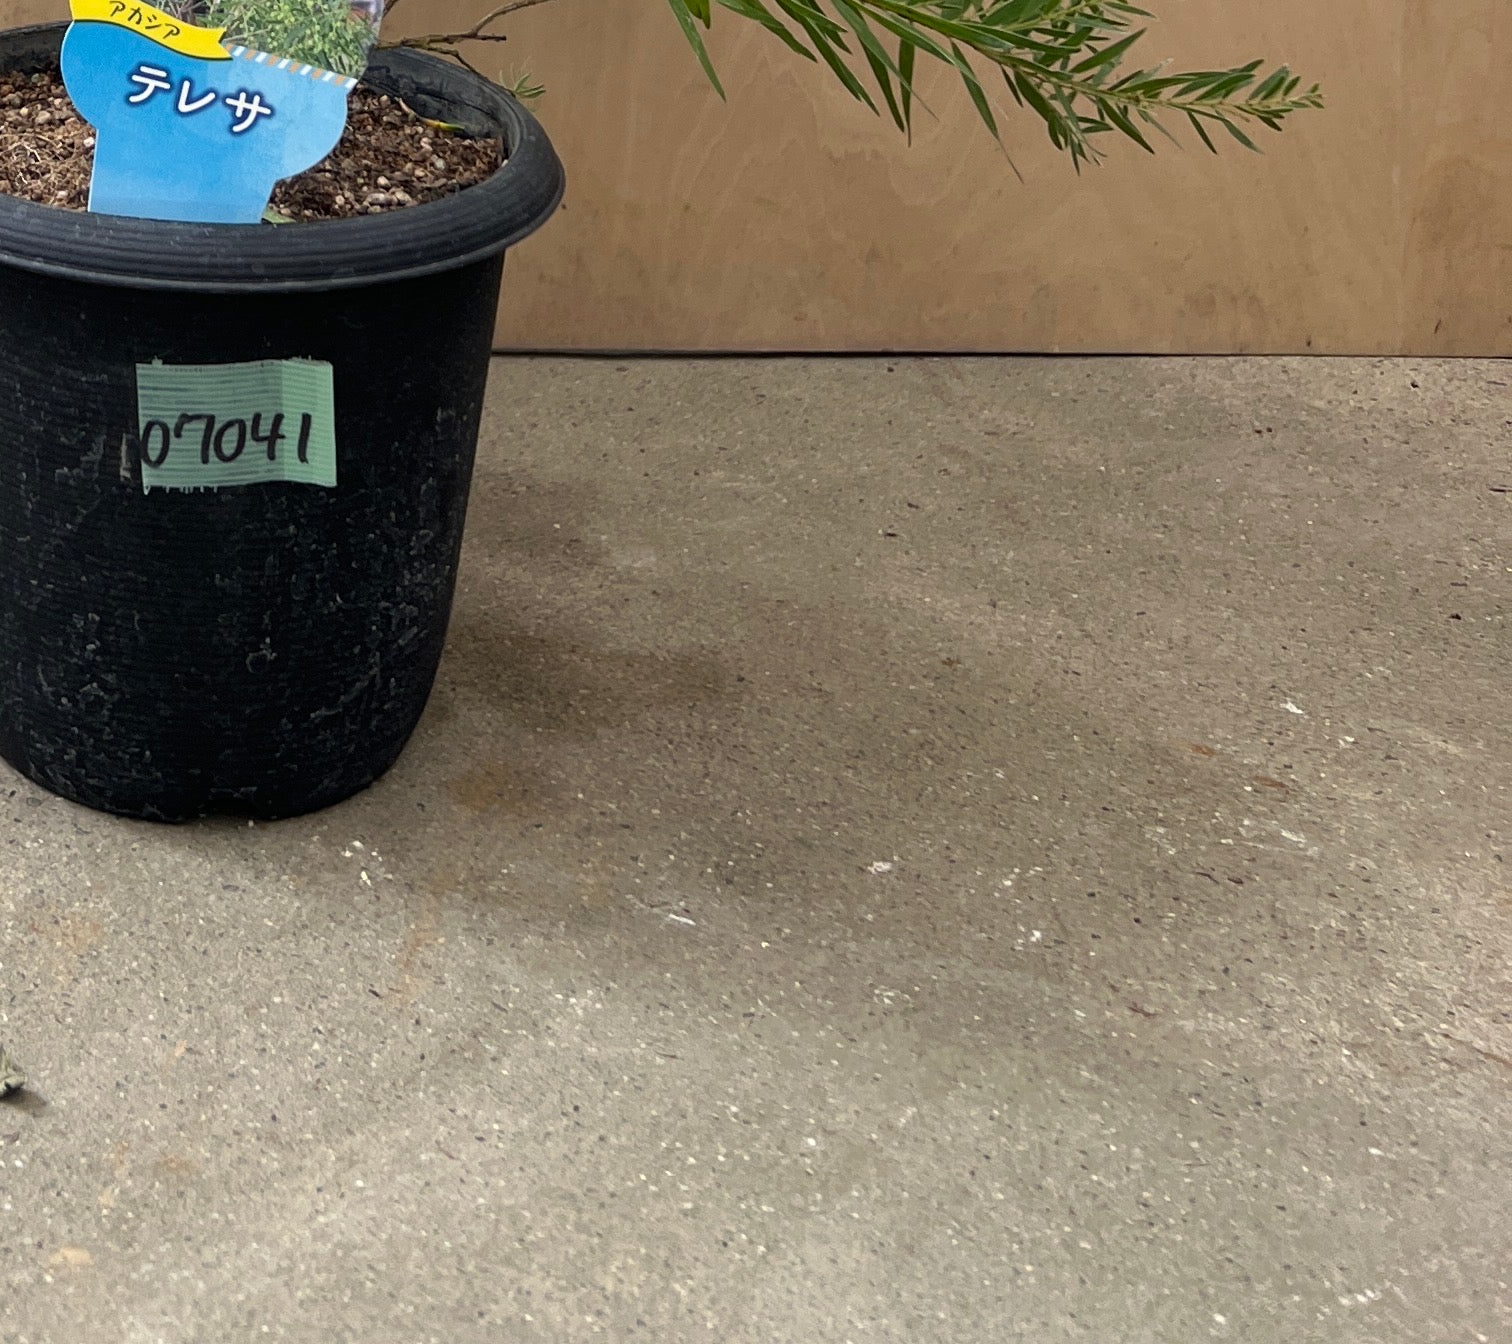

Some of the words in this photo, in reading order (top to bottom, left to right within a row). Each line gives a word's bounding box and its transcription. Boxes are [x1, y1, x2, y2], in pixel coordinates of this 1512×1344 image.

[109, 0, 181, 40] アカシア
[128, 65, 272, 133] テレサ
[140, 412, 312, 468] 07041
